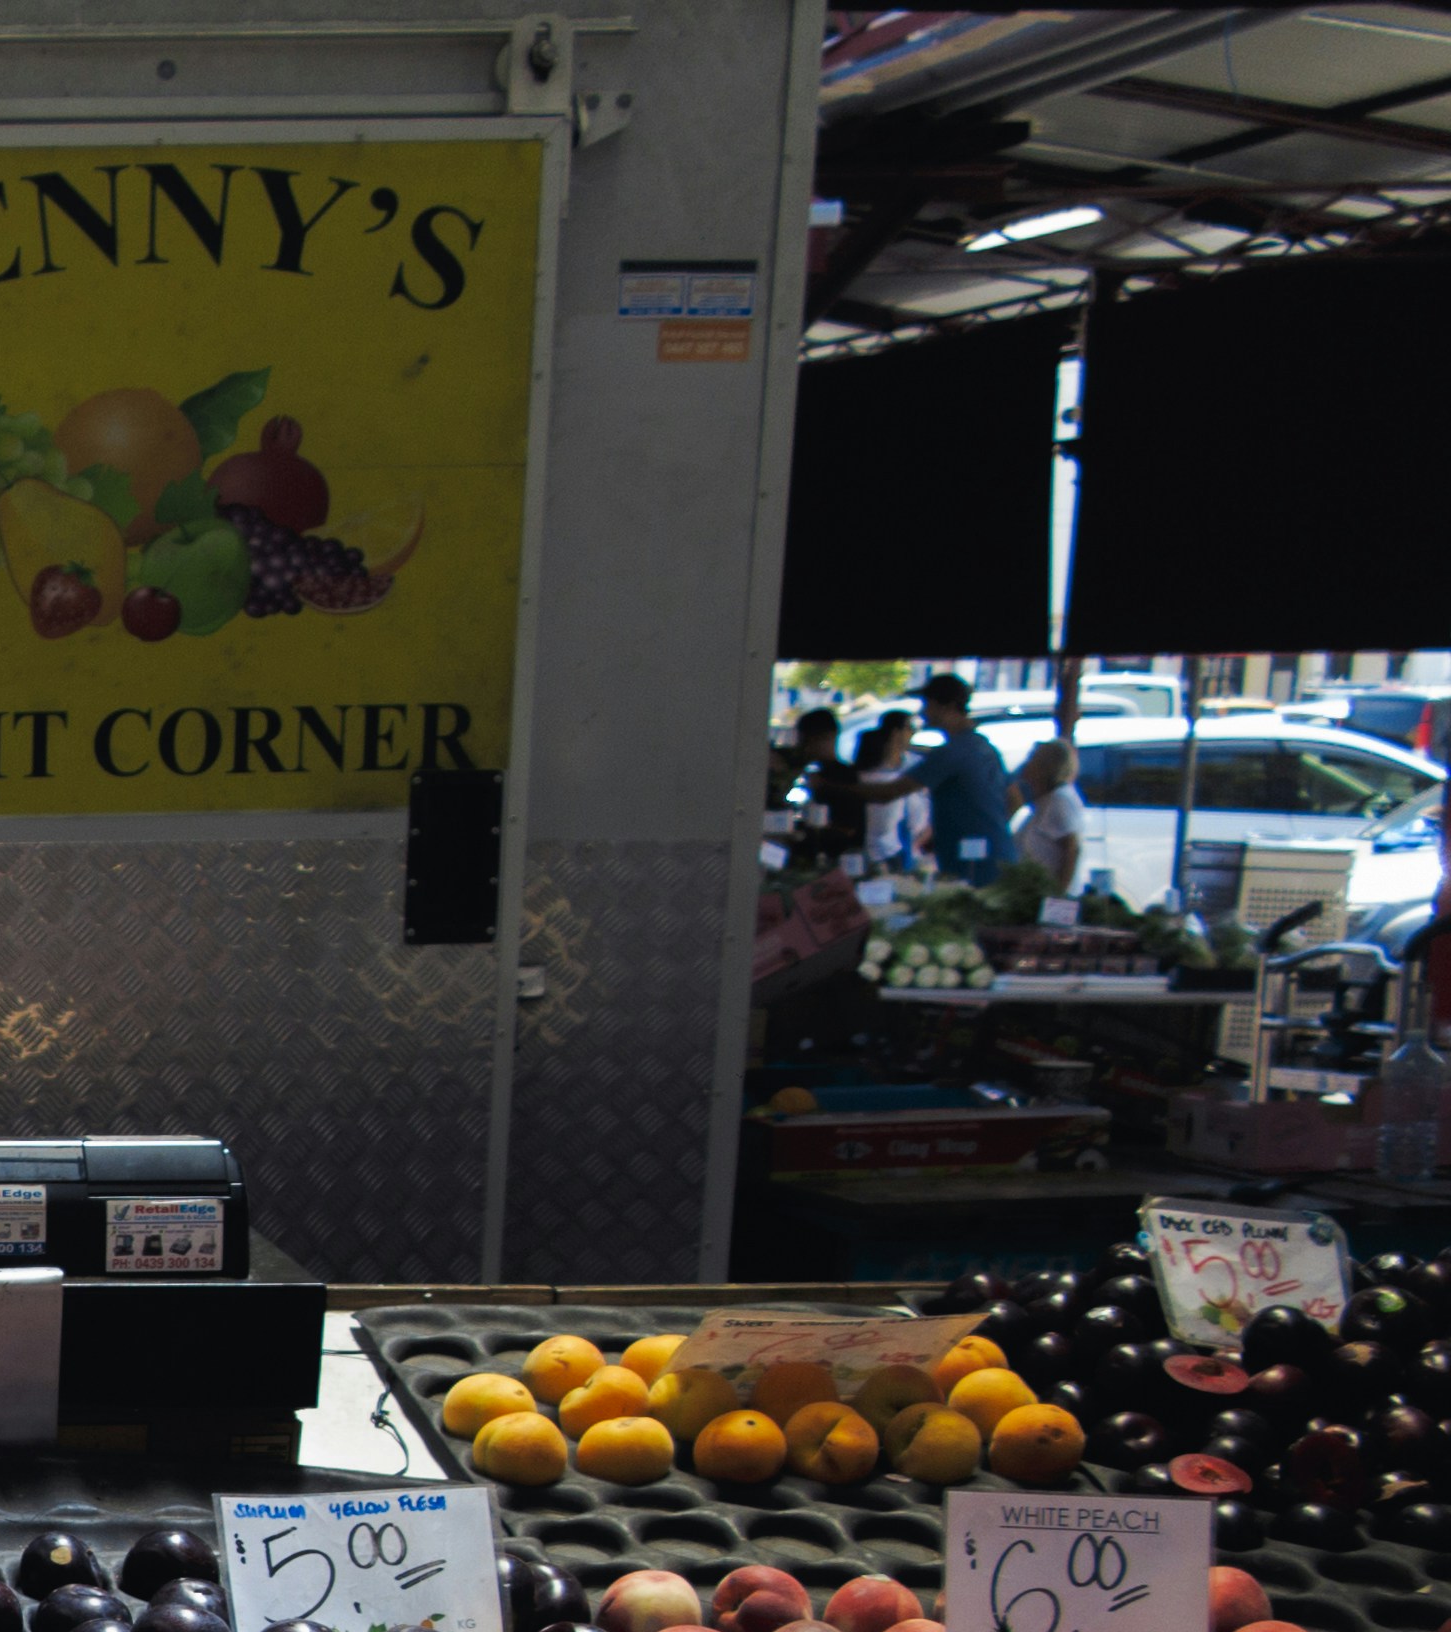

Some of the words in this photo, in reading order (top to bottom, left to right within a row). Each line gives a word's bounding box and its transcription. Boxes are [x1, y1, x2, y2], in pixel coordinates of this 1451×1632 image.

[93, 701, 481, 781] CORNER
[18, 1243, 43, 1253] 134
[112, 1258, 131, 1269] PH:
[135, 1258, 164, 1269] 0439
[168, 1258, 189, 1268] 300
[194, 1257, 215, 1268] 134
[1001, 1506, 1070, 1528] WHITE
[1078, 1508, 1160, 1530] PEACH
[457, 1619, 476, 1630] KG
